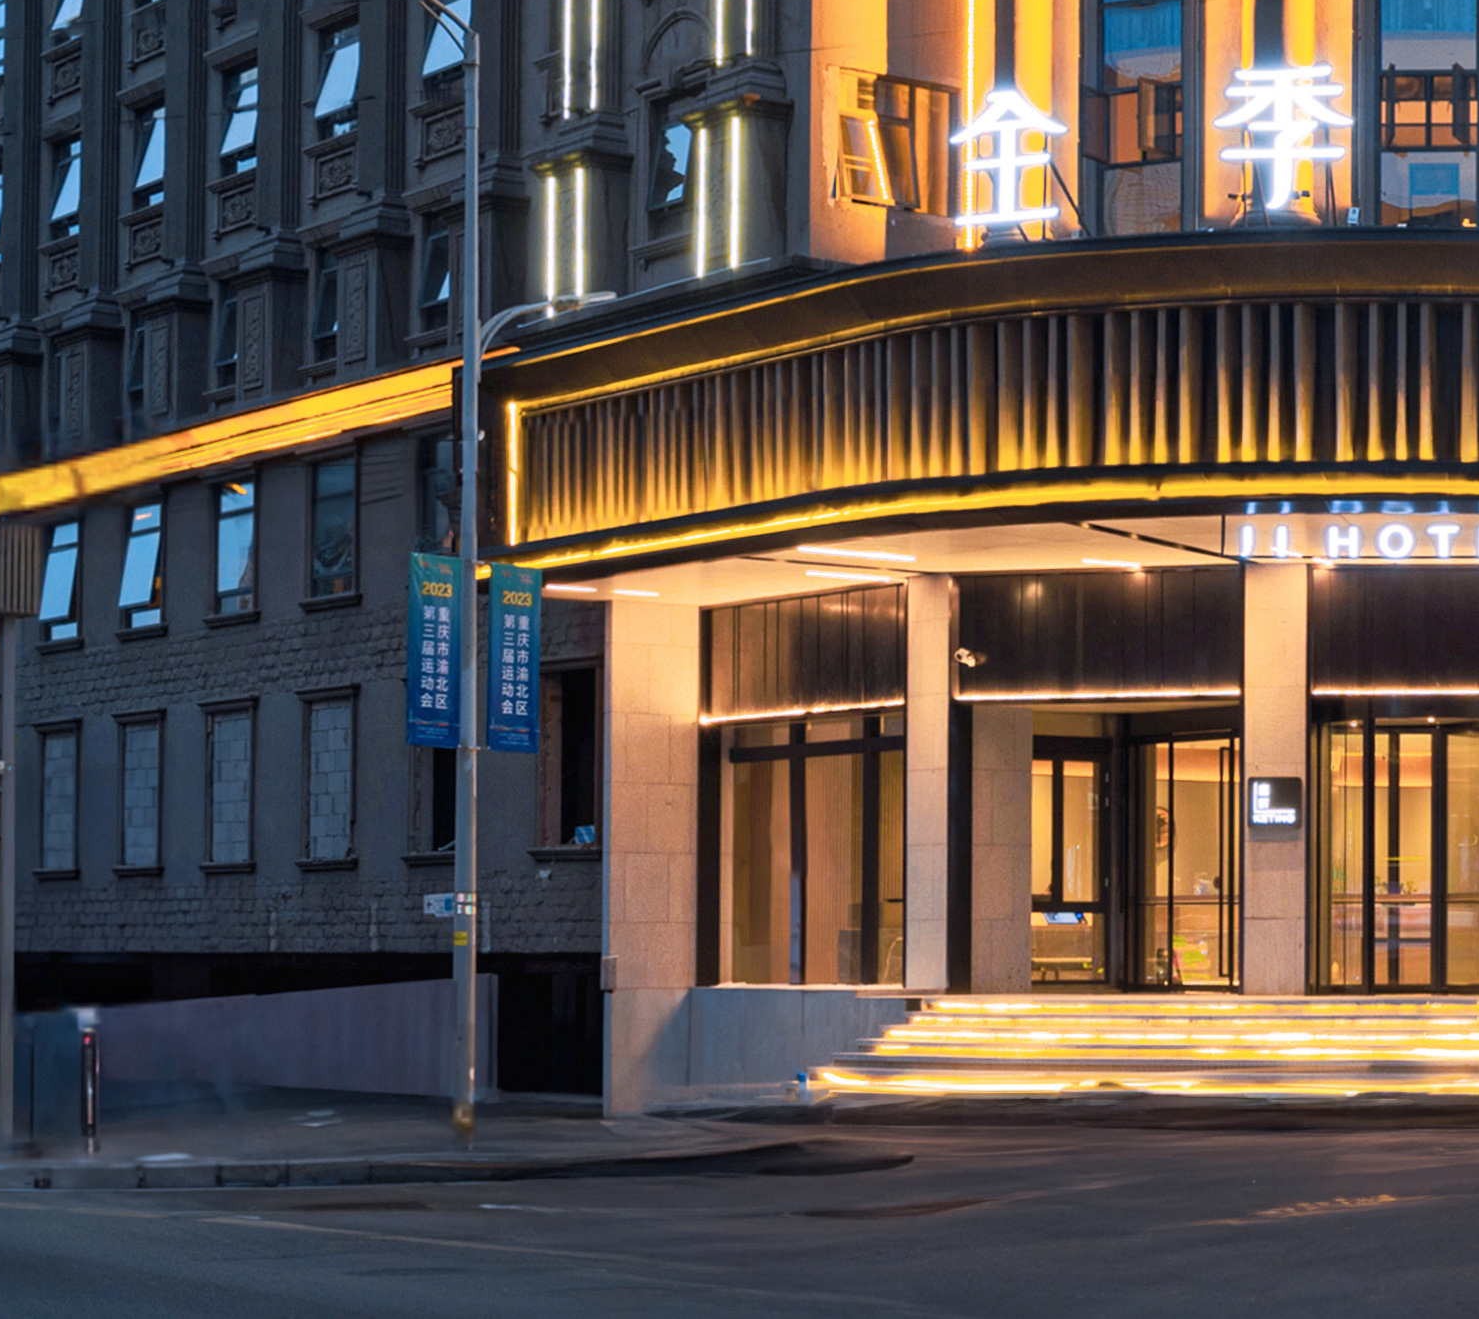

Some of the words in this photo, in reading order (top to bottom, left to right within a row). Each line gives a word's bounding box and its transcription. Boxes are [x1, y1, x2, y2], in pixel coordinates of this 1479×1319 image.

[422, 582, 453, 597] 2023
[502, 591, 533, 606] 2023
[420, 605, 436, 709] 第三届运动会
[435, 607, 451, 710] 重庆市渝北区
[501, 614, 516, 716] 第三届运动会
[515, 616, 530, 717] 重庆市渝北区
